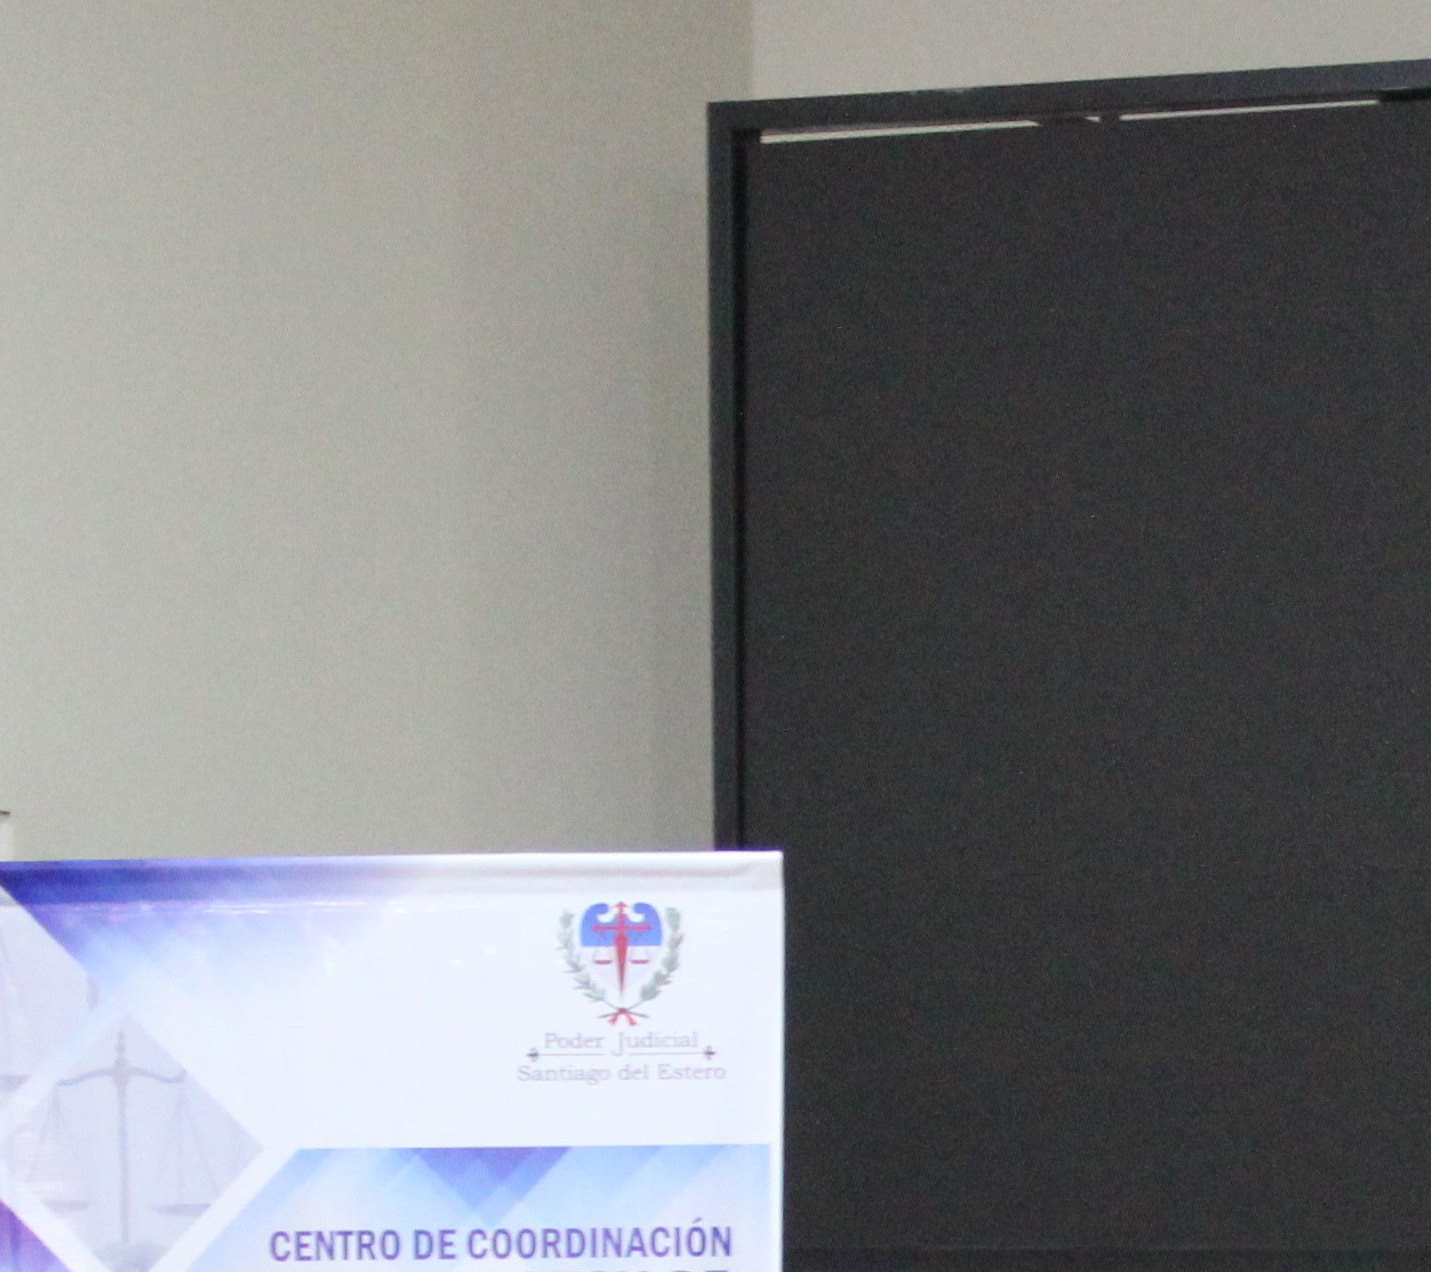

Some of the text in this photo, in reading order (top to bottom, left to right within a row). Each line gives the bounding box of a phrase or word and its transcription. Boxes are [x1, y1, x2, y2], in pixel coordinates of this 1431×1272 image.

[543, 1031, 699, 1057] Poder Judicial
[517, 1062, 727, 1086] Santiago del Estero
[270, 1218, 733, 1262] CENTRO DE COORDINACIÓN
